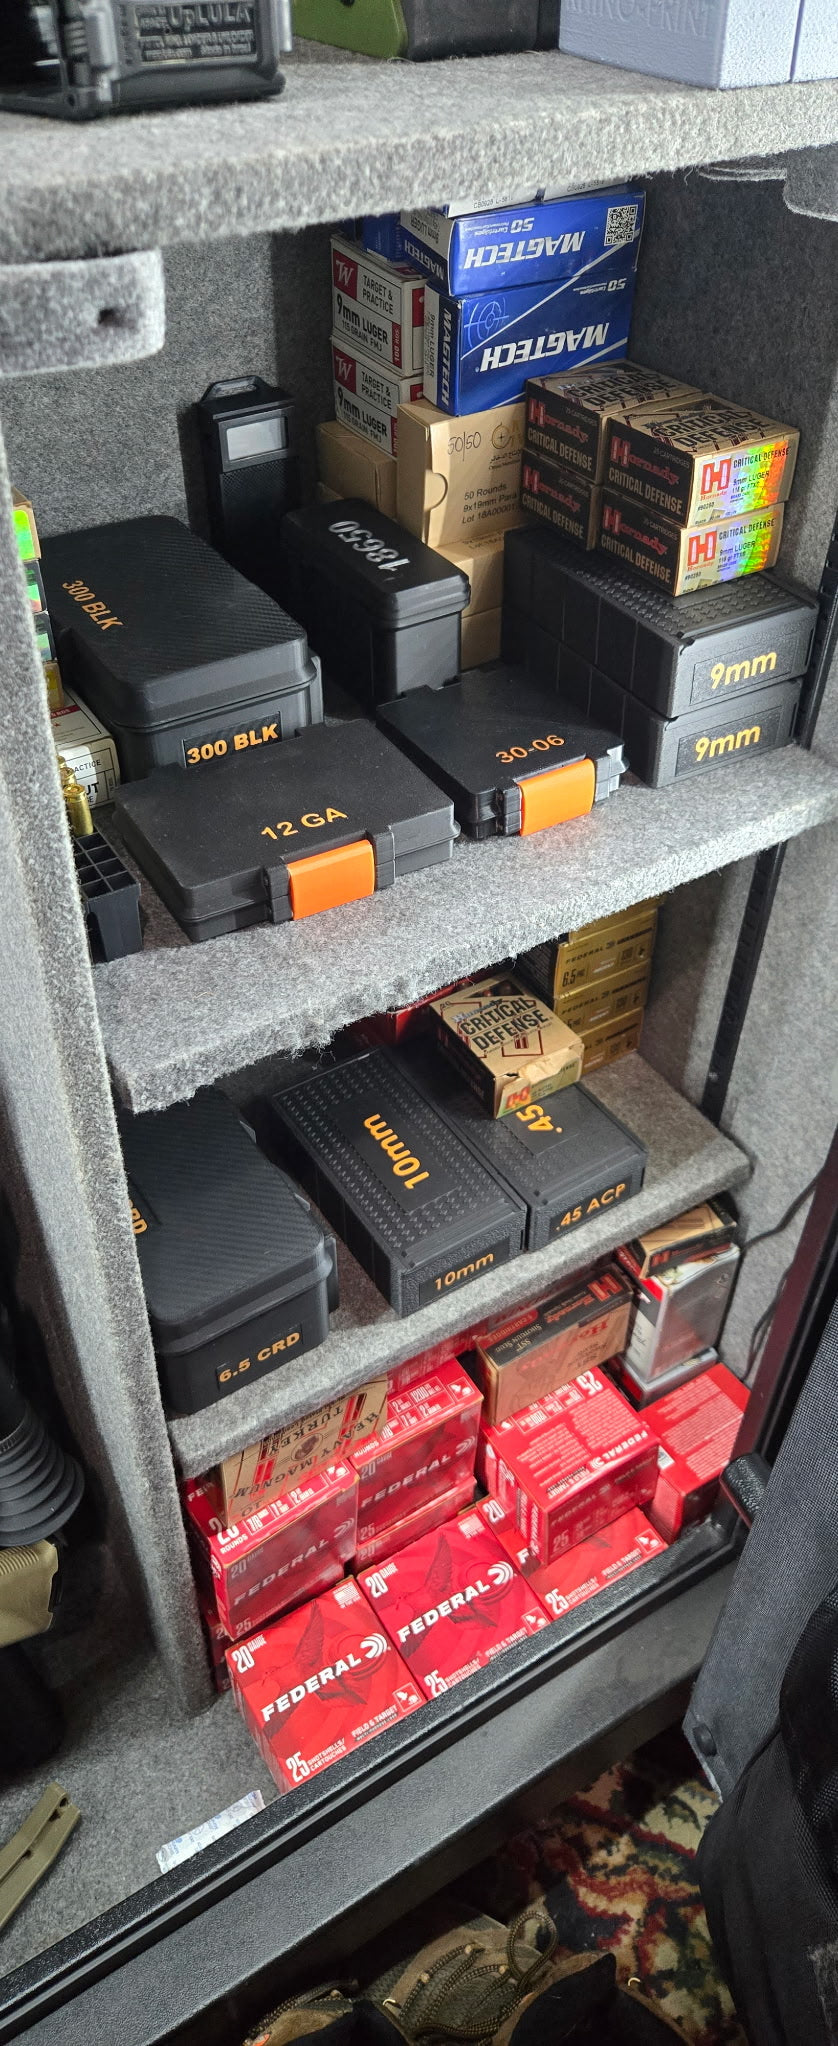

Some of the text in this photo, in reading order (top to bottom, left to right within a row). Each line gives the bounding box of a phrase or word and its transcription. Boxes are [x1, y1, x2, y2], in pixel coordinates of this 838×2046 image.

[510, 217, 535, 234] 50
[404, 239, 445, 281] MAGTECH
[464, 231, 586, 269] MAGTECH
[363, 275, 393, 300] TARGET &
[607, 277, 628, 292] 50
[363, 290, 394, 315] PRACTICE
[337, 294, 360, 326] 9mm
[362, 317, 389, 345] LUGER
[441, 307, 452, 408] MAGTECH
[480, 322, 610, 372] MAGTECH
[361, 384, 392, 410] PRACTICE
[362, 371, 391, 397] TARGET &
[566, 371, 662, 399] CRITICAL
[582, 378, 677, 407] DEFENSE
[338, 386, 388, 437] 9mm LUGER
[529, 399, 589, 443] Hornady
[655, 410, 752, 438] CRITICAL
[528, 427, 592, 470] CRITICAL DEFENSE
[672, 418, 770, 448] DEFENSE
[610, 436, 680, 484] Hornady
[733, 446, 790, 469] CRITICAL DEFENSE
[523, 465, 581, 512] Hornady
[608, 467, 644, 497] CRITICAL
[644, 485, 683, 515] DEFENSE
[748, 470, 770, 482] LUGER
[463, 498, 498, 513] 9x19mm
[464, 483, 507, 501] 50 Rounds
[462, 512, 475, 524] Lot
[522, 492, 584, 539] CRITICAL DEFENSE
[602, 505, 669, 556] Hornady
[719, 518, 775, 540] CRITICAL DEFENSE
[328, 519, 411, 573] 18650
[601, 534, 672, 584] CRITICAL DEFENSE
[734, 541, 756, 552] LUGER
[62, 580, 125, 632] 300 BLK
[710, 651, 777, 690] 9mm
[186, 723, 279, 765] 300 BLK
[495, 734, 566, 764] 30-06
[695, 725, 761, 763] 9mm
[74, 760, 102, 773] ACTICE
[260, 806, 350, 841] 12 GA
[562, 969, 577, 987] 6.5
[460, 996, 536, 1036] CRITICAL
[472, 1010, 549, 1051] DEFENSE
[515, 1104, 563, 1135] .45
[363, 1113, 430, 1190] 10mm
[555, 1182, 627, 1232] .45 ACP
[433, 1252, 494, 1292] 10mm
[545, 1294, 595, 1323] Hornady
[219, 1332, 300, 1383] 6.5 CRD
[515, 1340, 532, 1352] SST
[576, 1370, 603, 1397] 25
[268, 1406, 343, 1456] TURKEY
[320, 1411, 380, 1457] HEAVY
[603, 1430, 649, 1461] FEDERAL
[234, 1459, 313, 1499] MAGNUM
[360, 1454, 451, 1508] FEDERAL
[361, 1462, 376, 1480] 20
[482, 1500, 506, 1523] 20
[220, 1534, 249, 1554] ROUNDS
[360, 1523, 375, 1541] 25
[553, 1530, 569, 1553] 25
[231, 1562, 247, 1579] 20
[233, 1539, 329, 1606] FEDERAL
[365, 1572, 389, 1598] 20
[397, 1580, 491, 1643] FEDERAL
[545, 1588, 570, 1615] 25
[236, 1619, 250, 1635] 25
[485, 1647, 501, 1657] FIELD
[506, 1627, 528, 1645] TARGET
[231, 1634, 267, 1674] 20 GAUGE
[261, 1653, 361, 1722] FEDERAL
[424, 1670, 449, 1699] 25
[351, 1726, 369, 1738] FIELD
[375, 1705, 398, 1723] TARGET
[286, 1751, 310, 1783] 25
[308, 1738, 345, 1766] SHOTSHELLS/
[310, 1746, 347, 1772] CARTOUCHES
